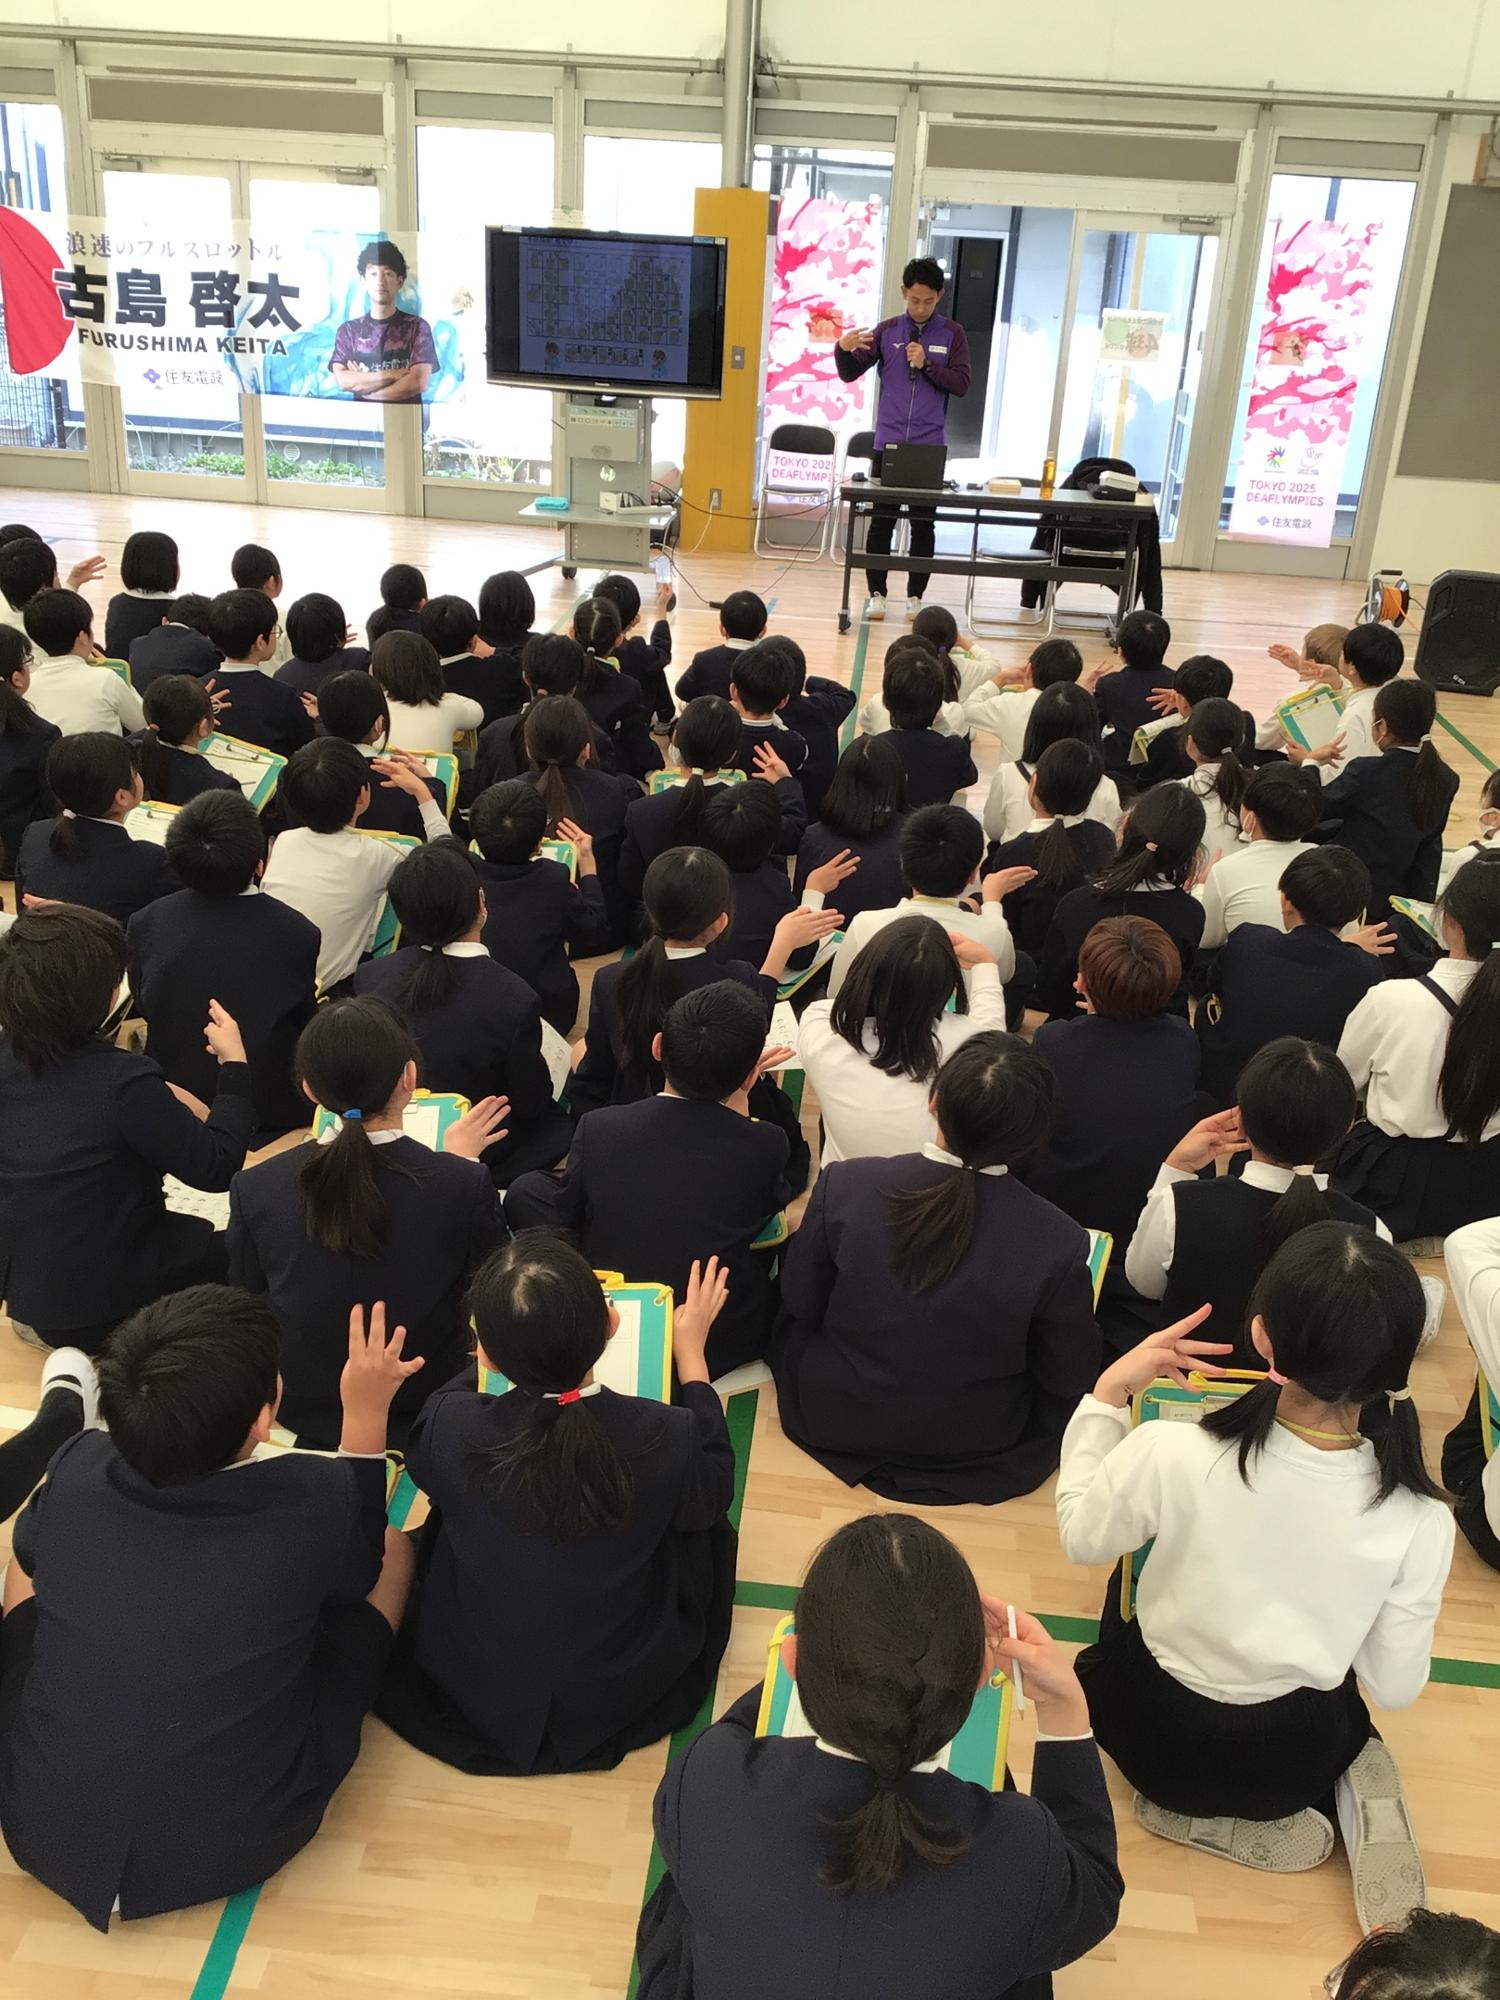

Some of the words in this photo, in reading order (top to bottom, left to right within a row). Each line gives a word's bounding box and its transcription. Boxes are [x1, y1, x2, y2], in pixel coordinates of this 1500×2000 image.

[65, 231, 282, 261] 浪速のフルスロットル
[77, 327, 208, 353] FURUSHIMA
[216, 336, 288, 356] KEITA
[165, 369, 225, 386] 住友電設
[775, 456, 809, 468] TOKYO
[812, 459, 834, 470] 202
[1250, 480, 1286, 492] TOKYO
[1289, 483, 1316, 494] 2025
[1247, 493, 1324, 506] DEAFLYMPICS
[1272, 517, 1312, 529] 住友電設
